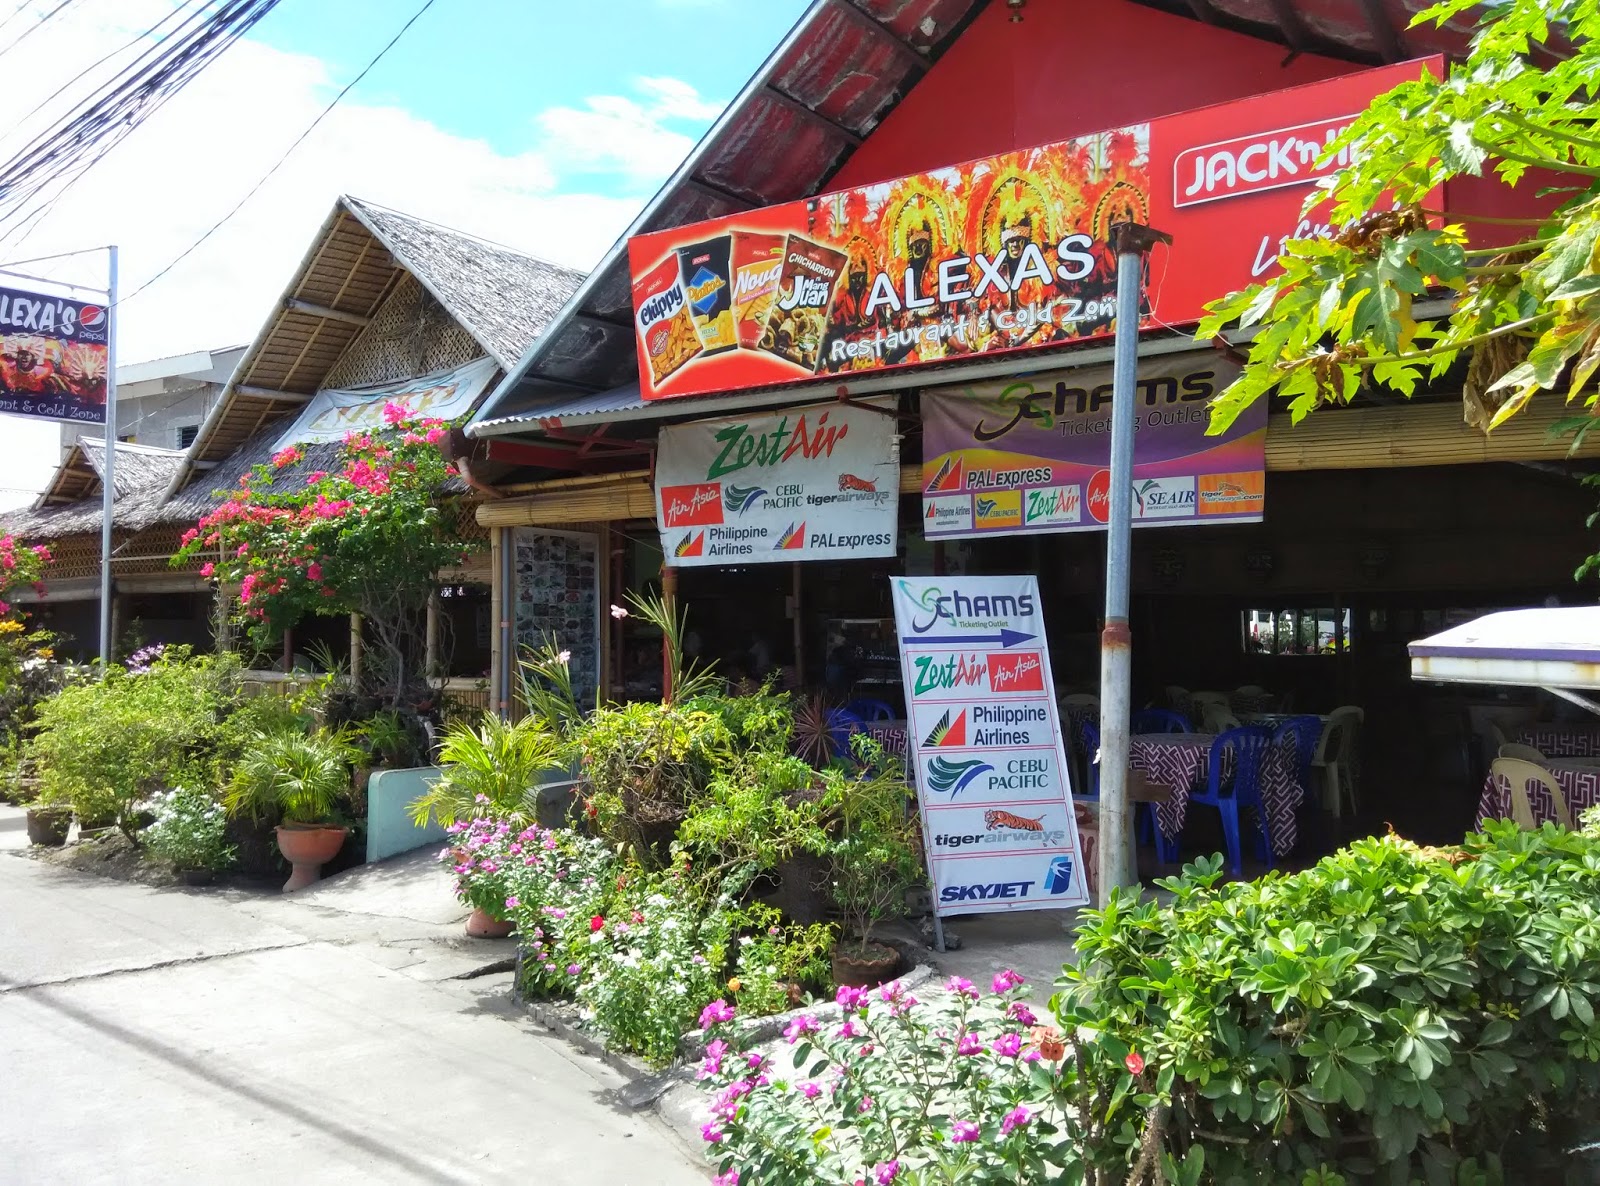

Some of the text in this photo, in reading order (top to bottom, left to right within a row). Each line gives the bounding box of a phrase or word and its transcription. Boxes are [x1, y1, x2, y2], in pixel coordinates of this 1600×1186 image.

[788, 252, 837, 278] CHICHARRON
[864, 233, 1096, 316] ALEXAS
[779, 275, 829, 311] Juan
[802, 279, 829, 291] Mang
[641, 282, 684, 326] Chippy
[0, 294, 77, 336] LEXA'S
[79, 331, 105, 341] pepsi
[831, 316, 969, 362] Restaurant
[1060, 296, 1117, 321] Zon
[22, 399, 34, 412] &
[37, 402, 66, 417] Cold
[70, 406, 101, 420] Zone
[1060, 415, 1142, 437] Ticketg
[706, 411, 848, 481] ZestAir
[966, 466, 1052, 490] PALExpress
[775, 484, 804, 496] CEBU
[806, 491, 891, 507] tigerairways
[1147, 490, 1195, 506] SEAIR
[763, 496, 804, 510] PACIFIC
[1027, 487, 1079, 523] ZestAir
[709, 526, 768, 542] Philippine
[810, 532, 892, 549] PALExpress
[709, 543, 753, 556] Airlines
[959, 620, 1009, 629] Ticketing Outlet
[914, 654, 987, 696] ZestAir
[973, 705, 1047, 726] Philippine
[974, 728, 1030, 746] Airlines
[1007, 758, 1049, 773] CEBU
[988, 774, 1049, 790] PACIFIC
[935, 829, 1065, 847] tigerairways
[939, 881, 1036, 902] SKYJET
